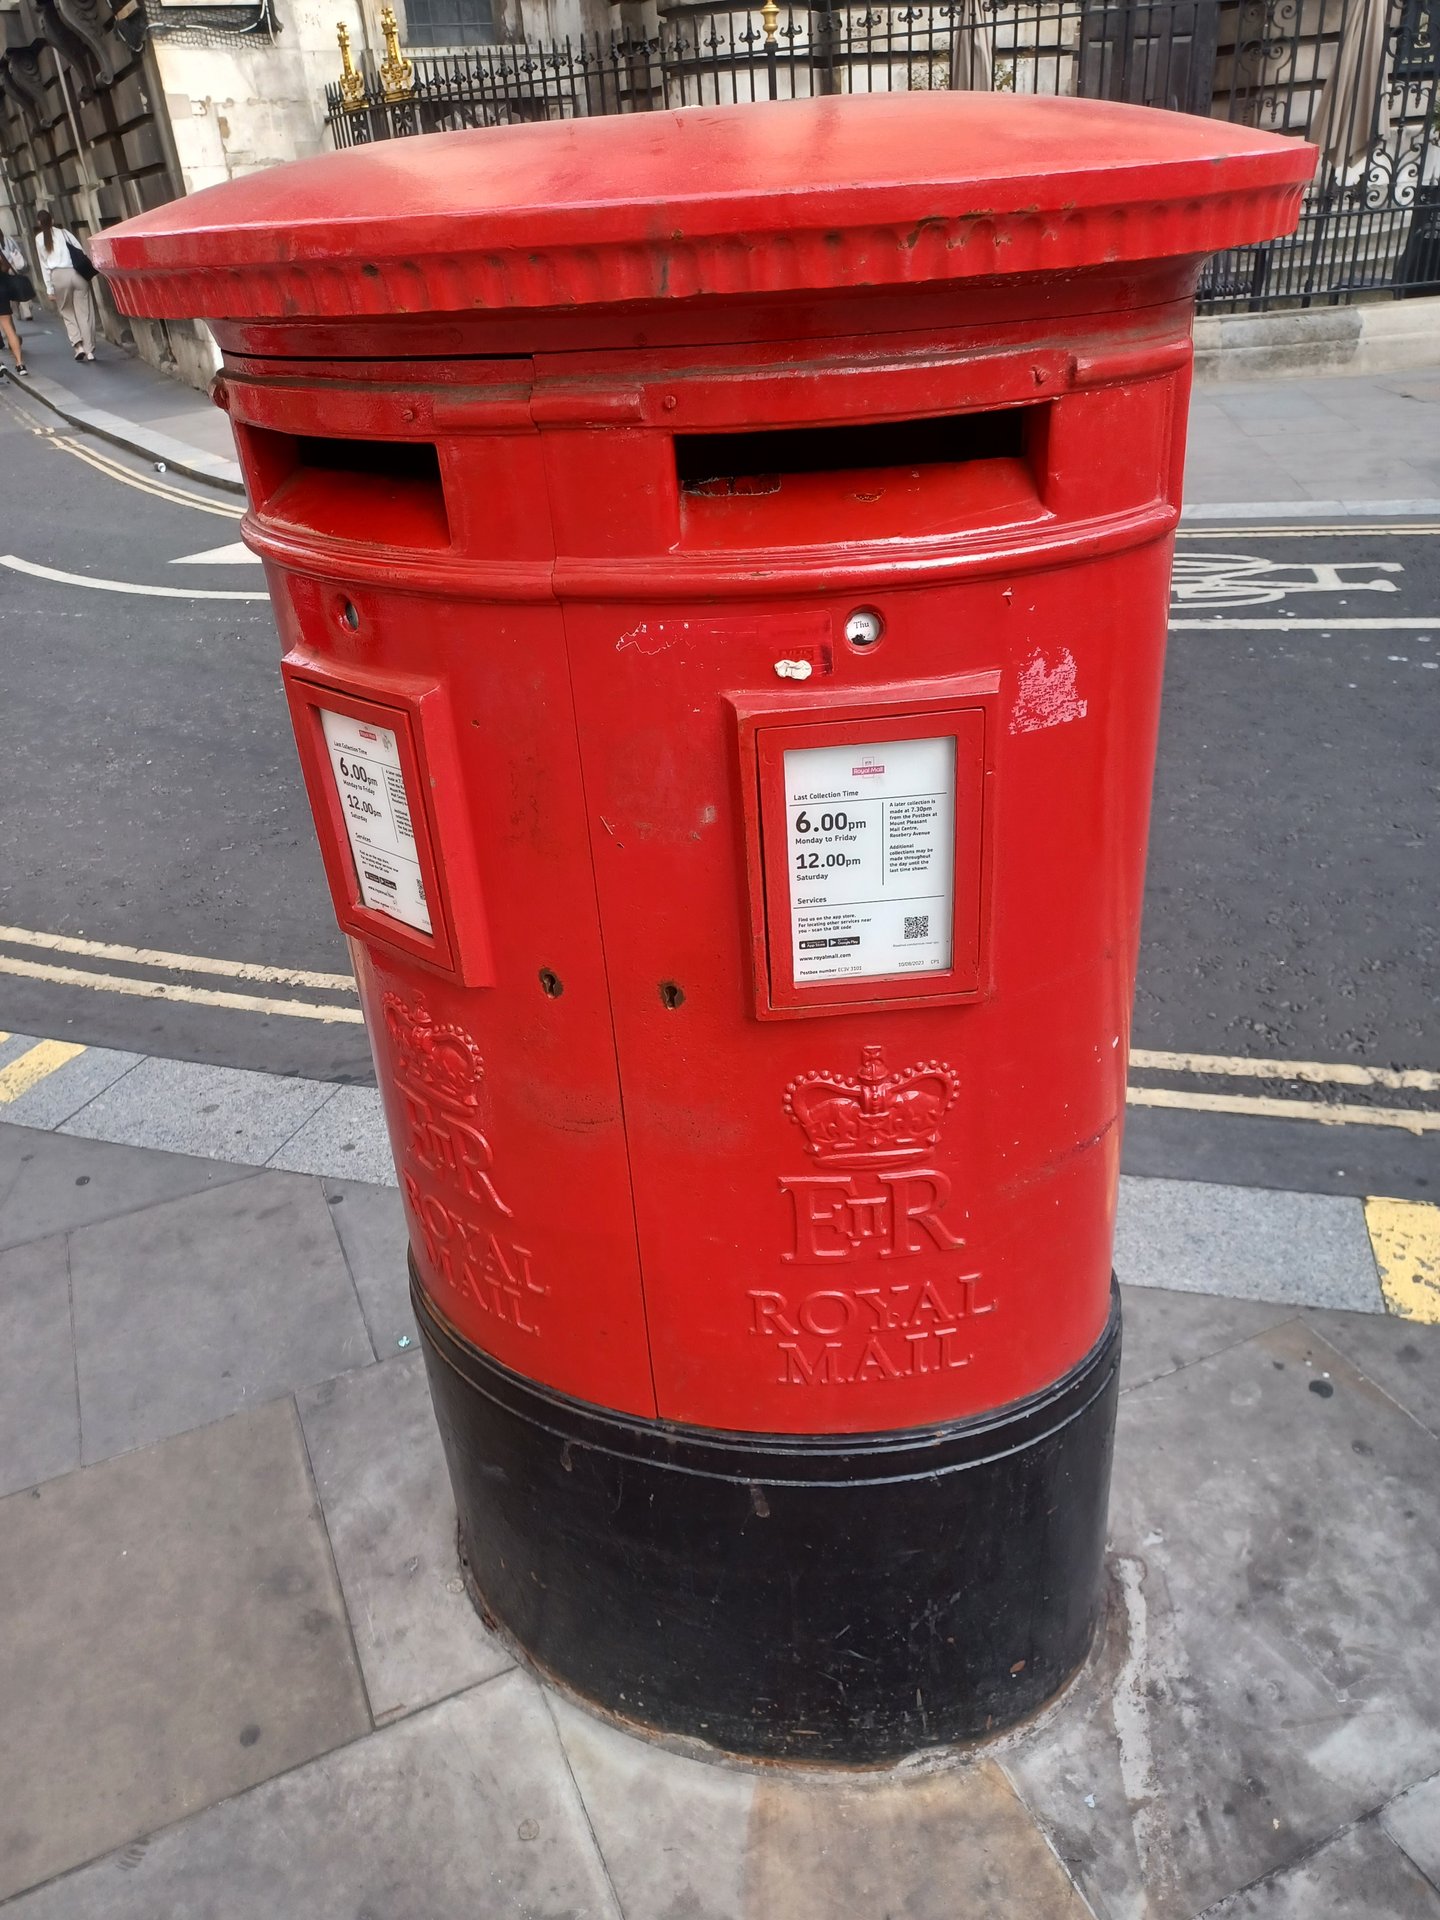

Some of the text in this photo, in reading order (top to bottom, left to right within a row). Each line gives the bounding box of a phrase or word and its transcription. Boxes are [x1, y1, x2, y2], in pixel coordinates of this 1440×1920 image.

[854, 621, 870, 629] Thu
[340, 757, 379, 786] 6.00pm
[809, 791, 841, 800] Collection
[842, 790, 859, 798] Time
[347, 794, 383, 817] 12.00pm
[795, 811, 867, 833] 6.00pm
[795, 836, 823, 845] Monday
[834, 834, 857, 843] Friday
[795, 853, 861, 870] 12.00pm
[796, 872, 829, 882] Saturday
[797, 896, 827, 905] Services
[800, 953, 851, 961] www.royalmail.com
[402, 1167, 551, 1296] ROYAL
[424, 1230, 542, 1337] MAIL
[748, 1272, 999, 1336] ROYAL
[777, 1328, 975, 1385] MAIL
